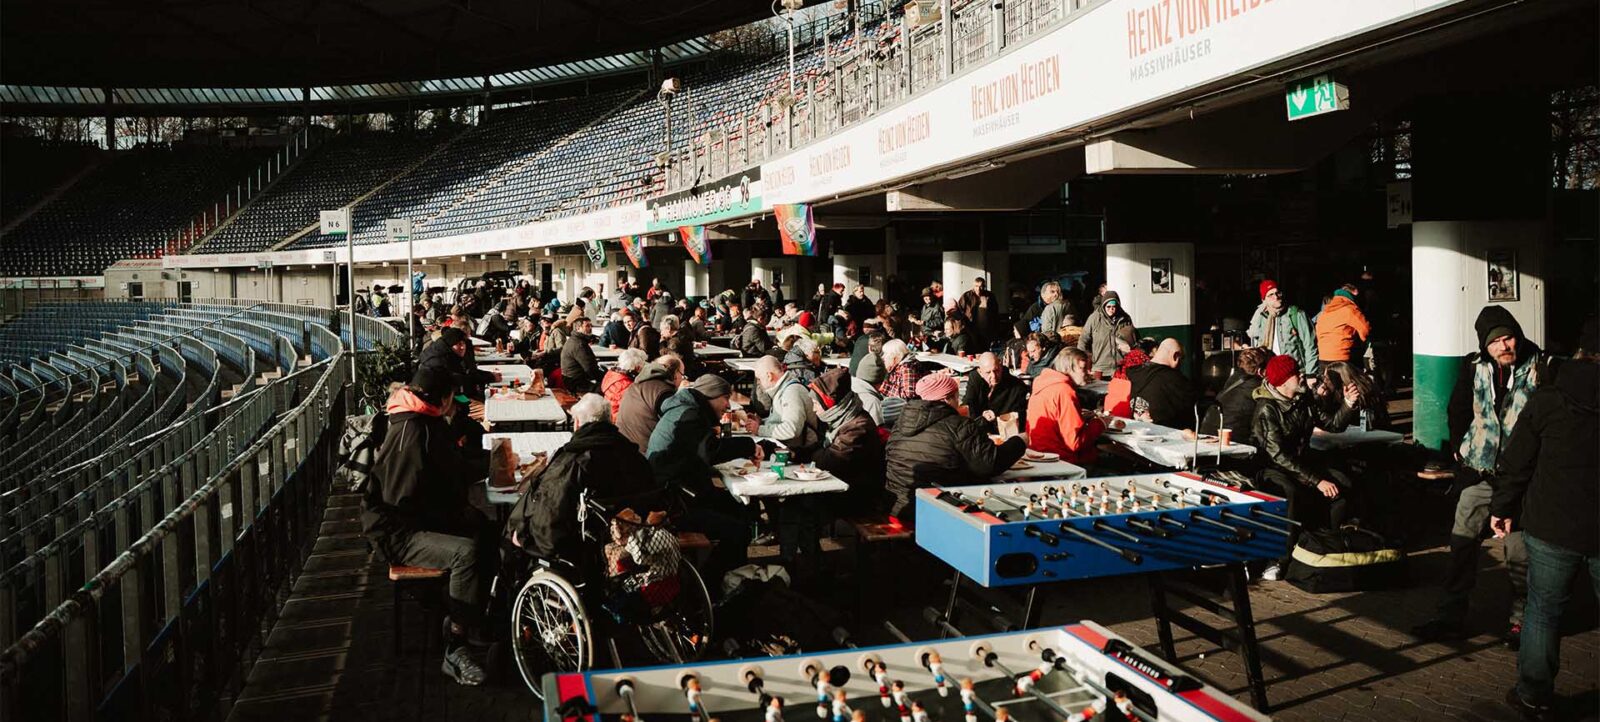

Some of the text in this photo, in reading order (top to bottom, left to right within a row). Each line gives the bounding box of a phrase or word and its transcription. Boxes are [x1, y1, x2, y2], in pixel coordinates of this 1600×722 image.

[1127, 0, 1172, 59] HEINZ
[971, 53, 1060, 121] HEINZ VON HEIDEN
[1130, 38, 1212, 82] MASSIVHÄUSER
